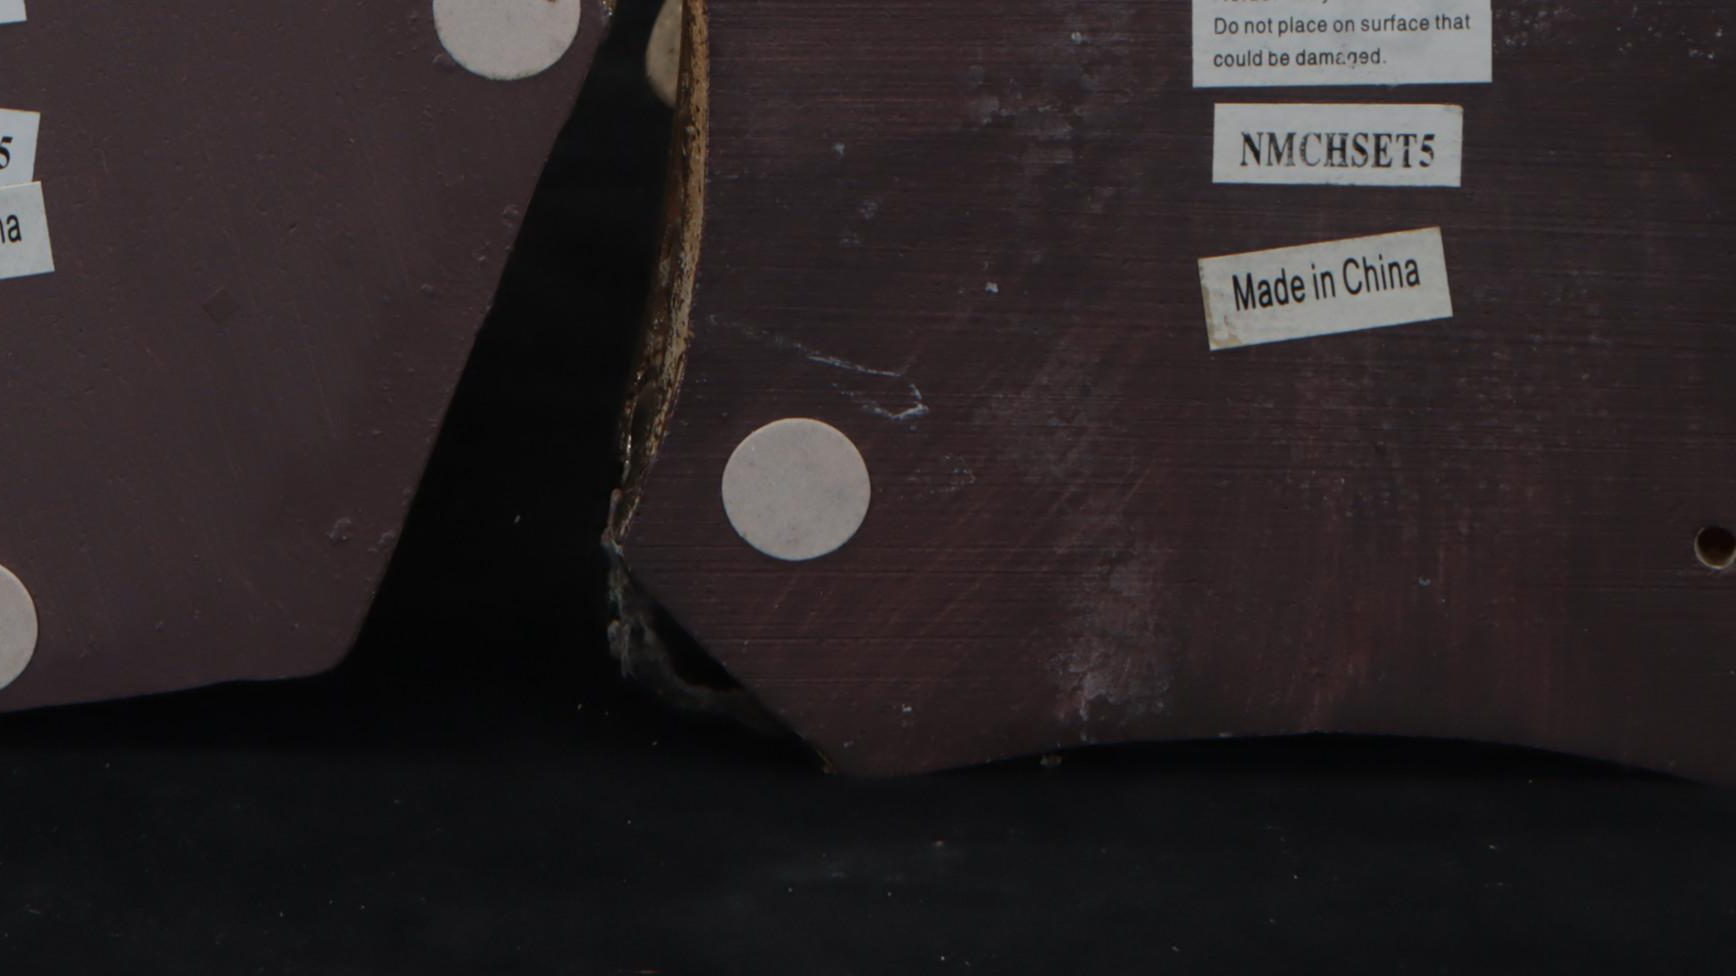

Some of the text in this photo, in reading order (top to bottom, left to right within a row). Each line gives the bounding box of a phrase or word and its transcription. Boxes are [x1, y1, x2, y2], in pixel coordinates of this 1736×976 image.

[1213, 13, 1471, 37] Do not place on surface that
[1213, 50, 1263, 68] could
[1267, 49, 1290, 67] be
[1239, 131, 1436, 169] NMCHSET5
[1231, 254, 1421, 312] Made in China
